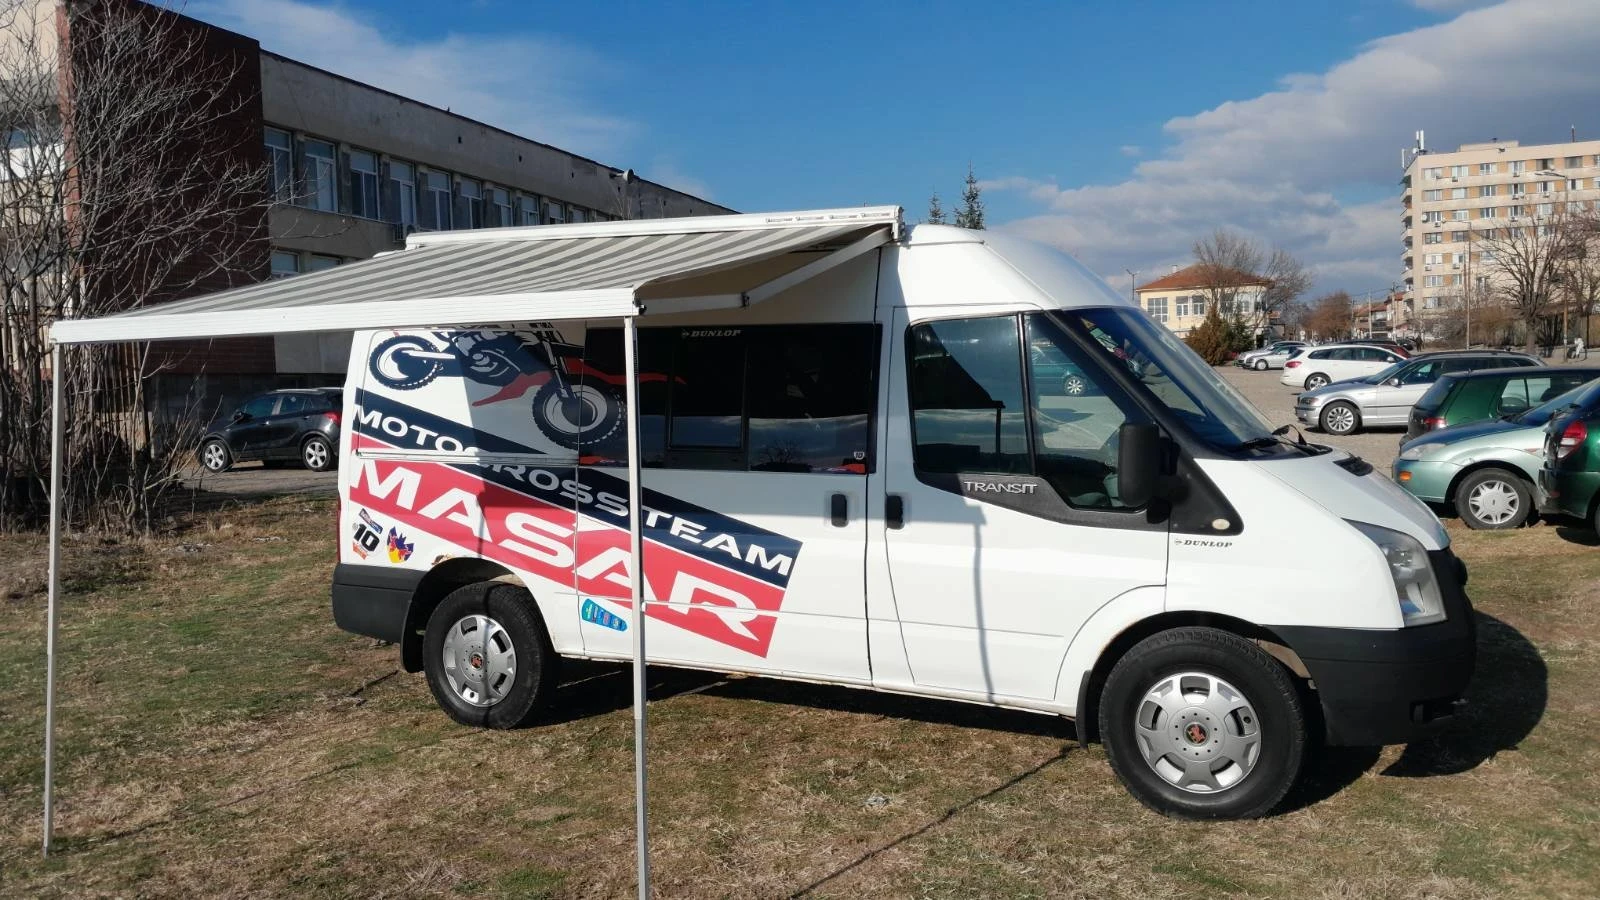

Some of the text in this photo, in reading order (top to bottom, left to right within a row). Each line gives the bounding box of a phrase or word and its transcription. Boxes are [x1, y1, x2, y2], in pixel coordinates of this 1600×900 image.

[690, 329, 742, 337] DUNLOP
[963, 481, 1038, 495] TRANSIT
[353, 523, 380, 552] 10
[1183, 539, 1233, 548] DUNLOP
[350, 452, 760, 642] MASAR
